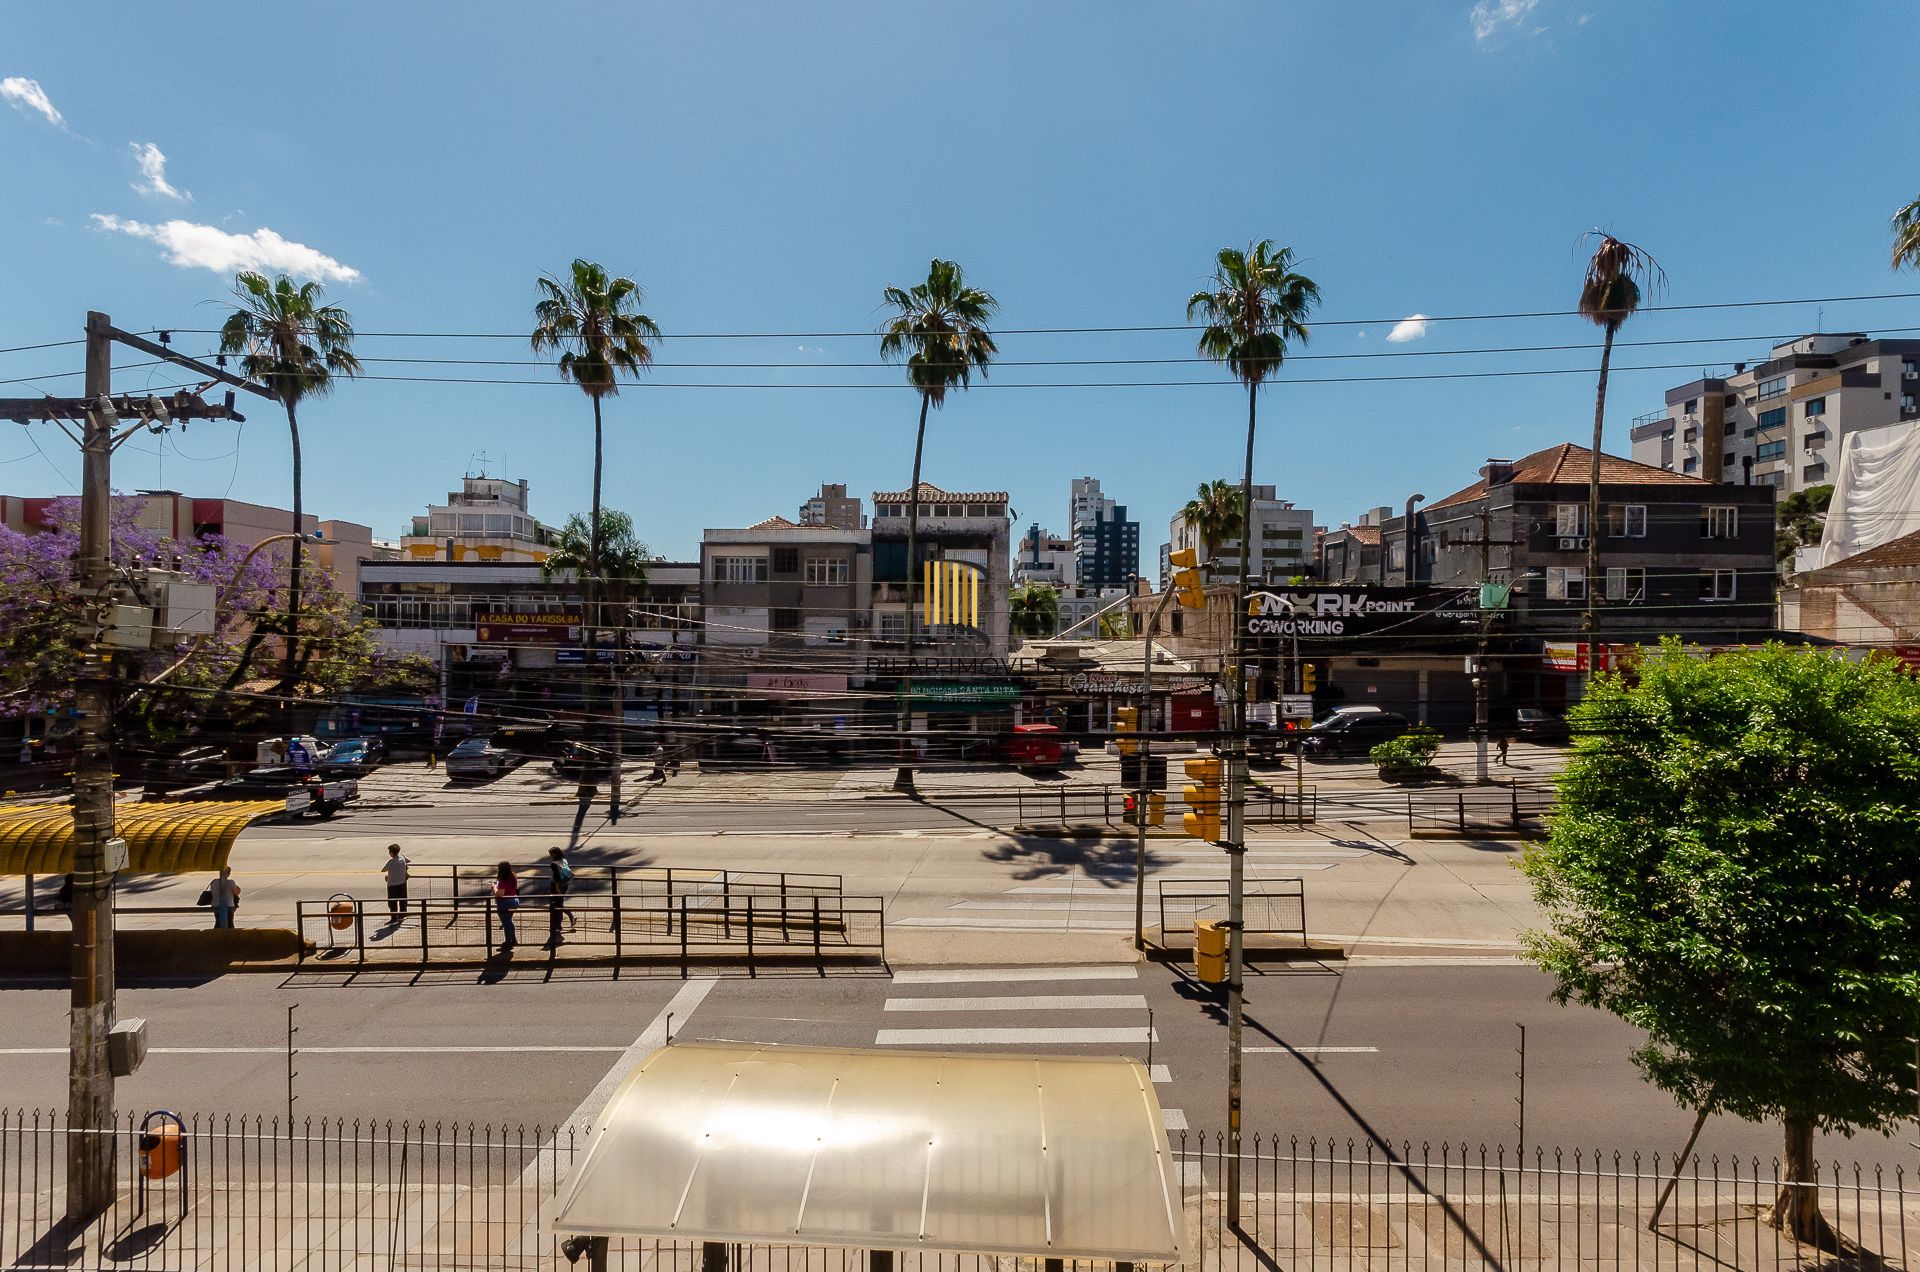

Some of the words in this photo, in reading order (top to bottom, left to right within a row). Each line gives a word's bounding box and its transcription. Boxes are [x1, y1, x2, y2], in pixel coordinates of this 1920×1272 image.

[1367, 601, 1415, 613] POINT
[480, 615, 487, 624] A
[489, 615, 513, 624] CASA
[515, 614, 528, 624] DO
[1248, 619, 1344, 635] COWORKING
